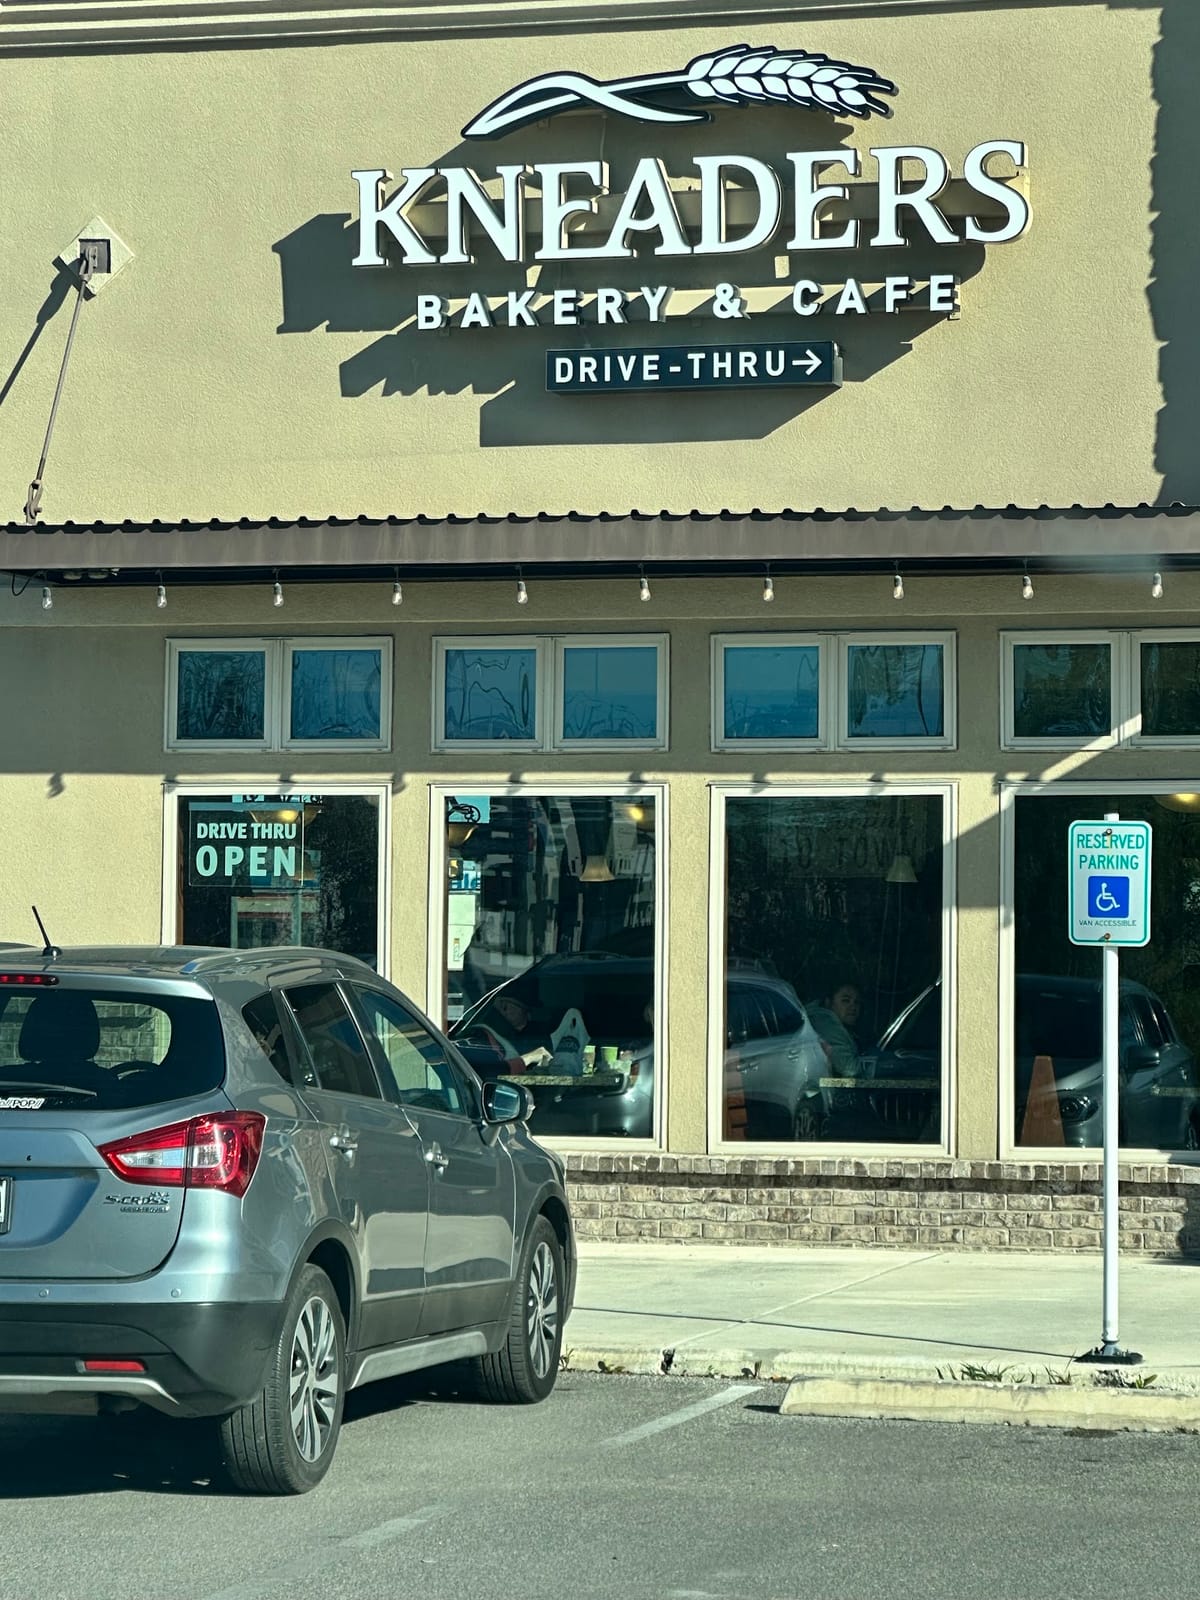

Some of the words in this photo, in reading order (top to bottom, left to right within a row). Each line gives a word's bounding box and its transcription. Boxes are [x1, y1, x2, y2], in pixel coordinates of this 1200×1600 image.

[351, 140, 1032, 267] KNEADERS
[417, 286, 668, 330] BAKERY
[712, 282, 745, 319] &
[792, 274, 955, 316] CAFE
[554, 350, 786, 383] DRIVE-THRU
[197, 822, 248, 840] DRIVE
[251, 822, 297, 840] THRU
[1077, 834, 1145, 849] RESERVED
[195, 845, 296, 877] OPEN
[1079, 855, 1139, 870] PARKING
